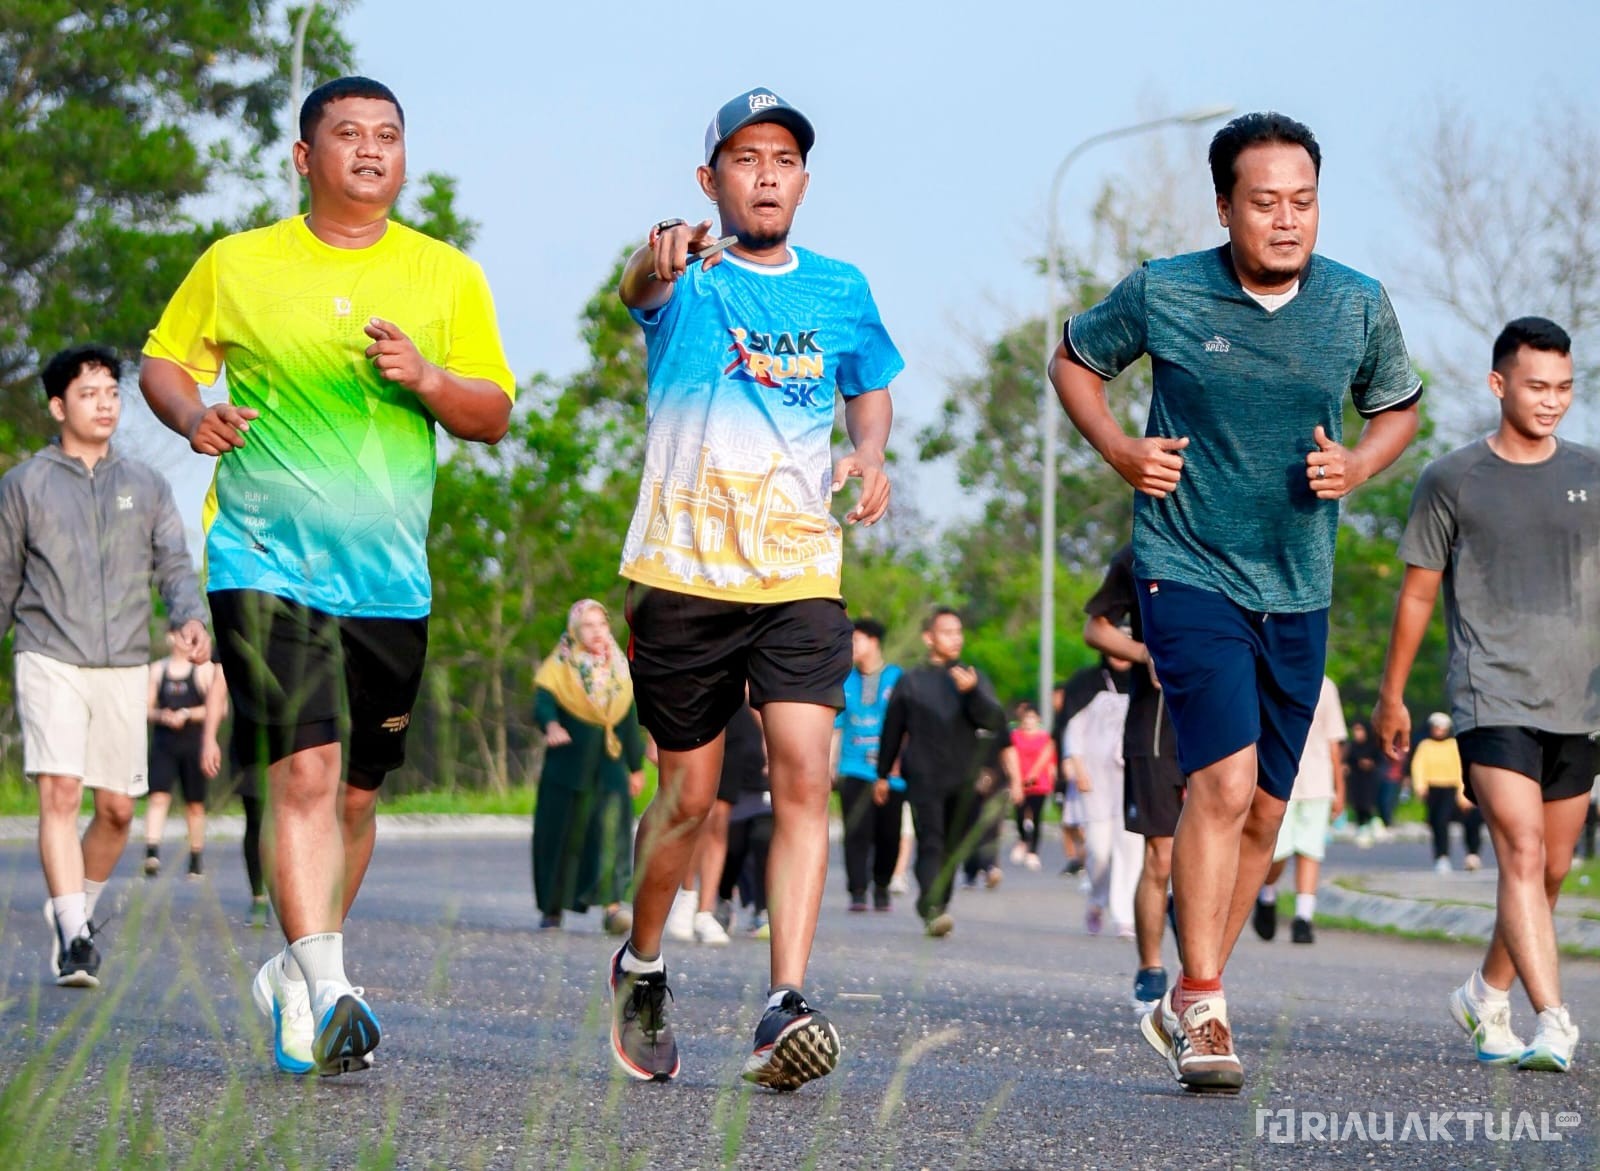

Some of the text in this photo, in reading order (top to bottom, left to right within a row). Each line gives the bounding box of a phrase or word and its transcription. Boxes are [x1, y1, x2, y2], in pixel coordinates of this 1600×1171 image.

[748, 329, 823, 355] SIAK
[1205, 343, 1230, 352] SPECS
[749, 353, 824, 379] RUN
[782, 383, 819, 407] 5K
[244, 491, 261, 502] RUN
